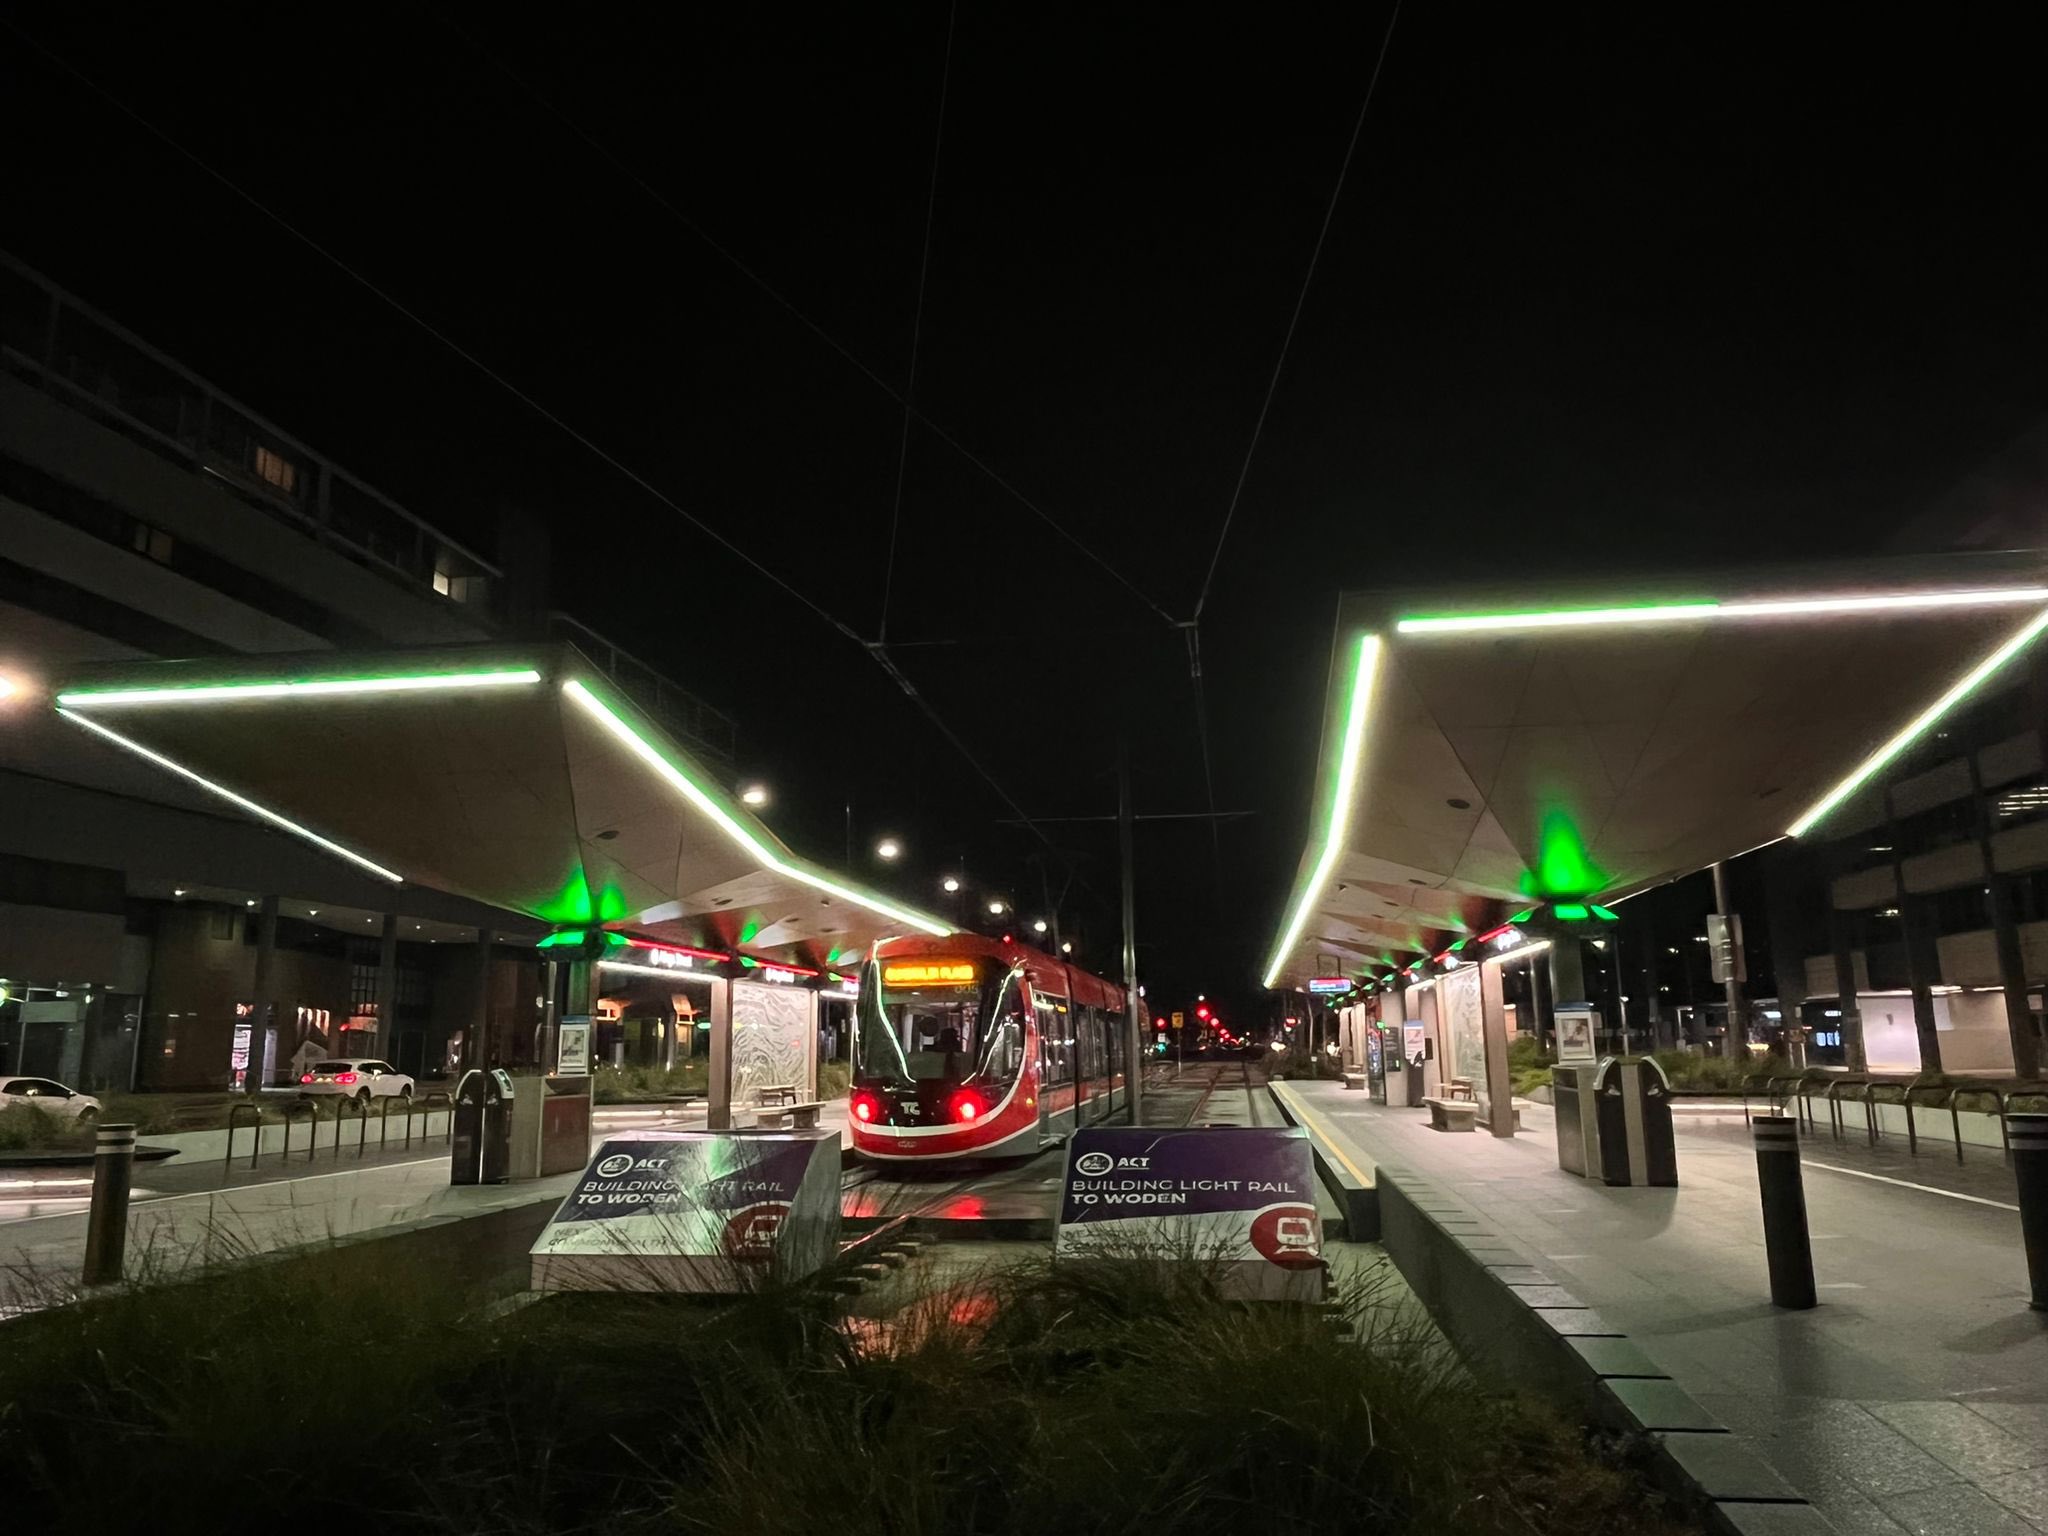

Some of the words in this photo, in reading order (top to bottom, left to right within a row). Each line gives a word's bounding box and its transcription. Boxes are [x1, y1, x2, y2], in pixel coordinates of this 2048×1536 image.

[635, 1158, 668, 1169] ACT
[1117, 1157, 1150, 1167] ACT
[741, 1180, 785, 1193] RAIL
[1072, 1180, 1173, 1192] BUILDING
[1180, 1180, 1242, 1192] LIGHT
[1248, 1181, 1297, 1194] RAIL
[577, 1194, 605, 1205] TO
[608, 1193, 681, 1205] WODEN
[1072, 1193, 1099, 1205] TO
[1104, 1193, 1186, 1204] WODEN
